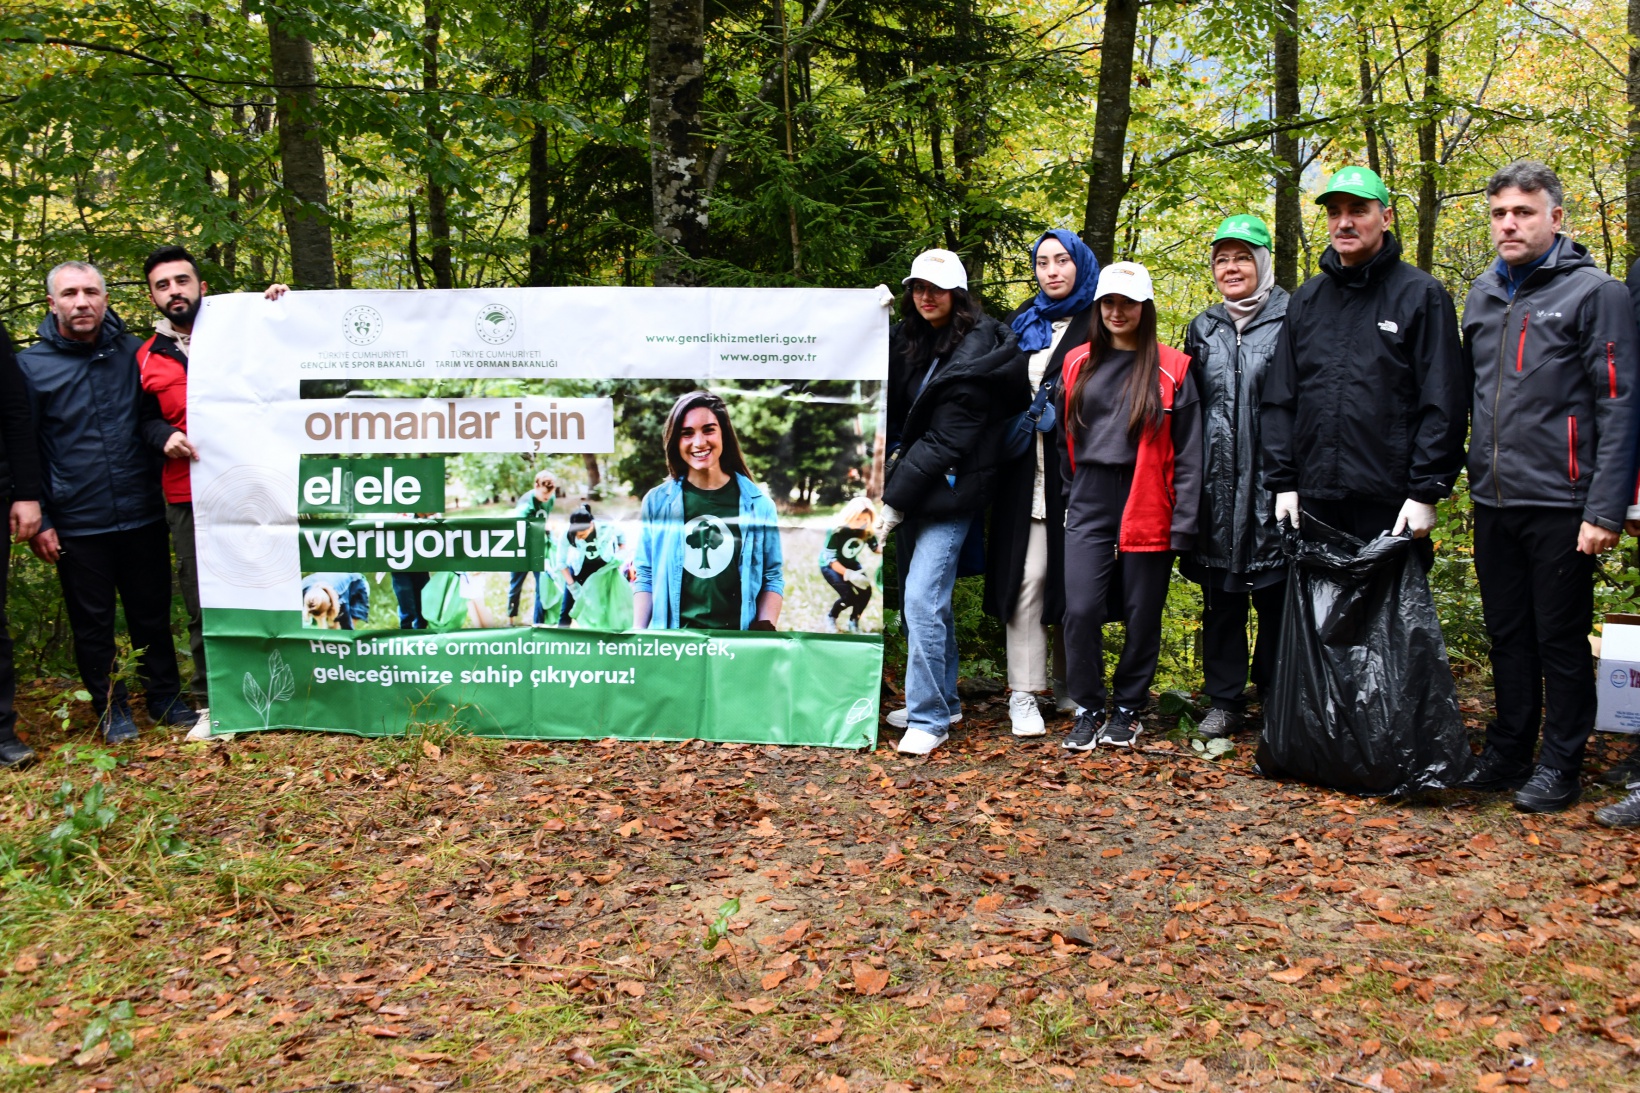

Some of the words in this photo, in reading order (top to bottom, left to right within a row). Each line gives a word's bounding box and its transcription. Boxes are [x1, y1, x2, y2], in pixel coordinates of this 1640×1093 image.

[646, 333, 817, 345] www.genclikhizmetleri.gov.tr
[318, 351, 349, 359] TÜRKİYE
[352, 350, 408, 358] CUMHURİYETİ
[450, 350, 484, 358] TÜRKİYE
[486, 350, 541, 358] CUMHURİYETİ
[720, 353, 817, 363] www.ogm.gov.tr
[300, 361, 337, 370] GENÇLİK
[378, 359, 425, 368] BAKANLIĞI
[512, 359, 558, 367] BAKANLIĞI
[305, 403, 499, 440] ormanlar
[515, 402, 585, 451] için
[303, 467, 342, 504] el
[354, 467, 421, 504] ele
[303, 521, 526, 570] veriyoruz!
[310, 640, 350, 659] Hep
[357, 638, 437, 656] birlikte
[446, 637, 591, 655] ormanlarımızı
[597, 638, 735, 661] temizleyerek,
[314, 665, 453, 686] geleceğimize
[460, 664, 523, 687] sahip
[530, 666, 635, 688] çıkıyoruz!
